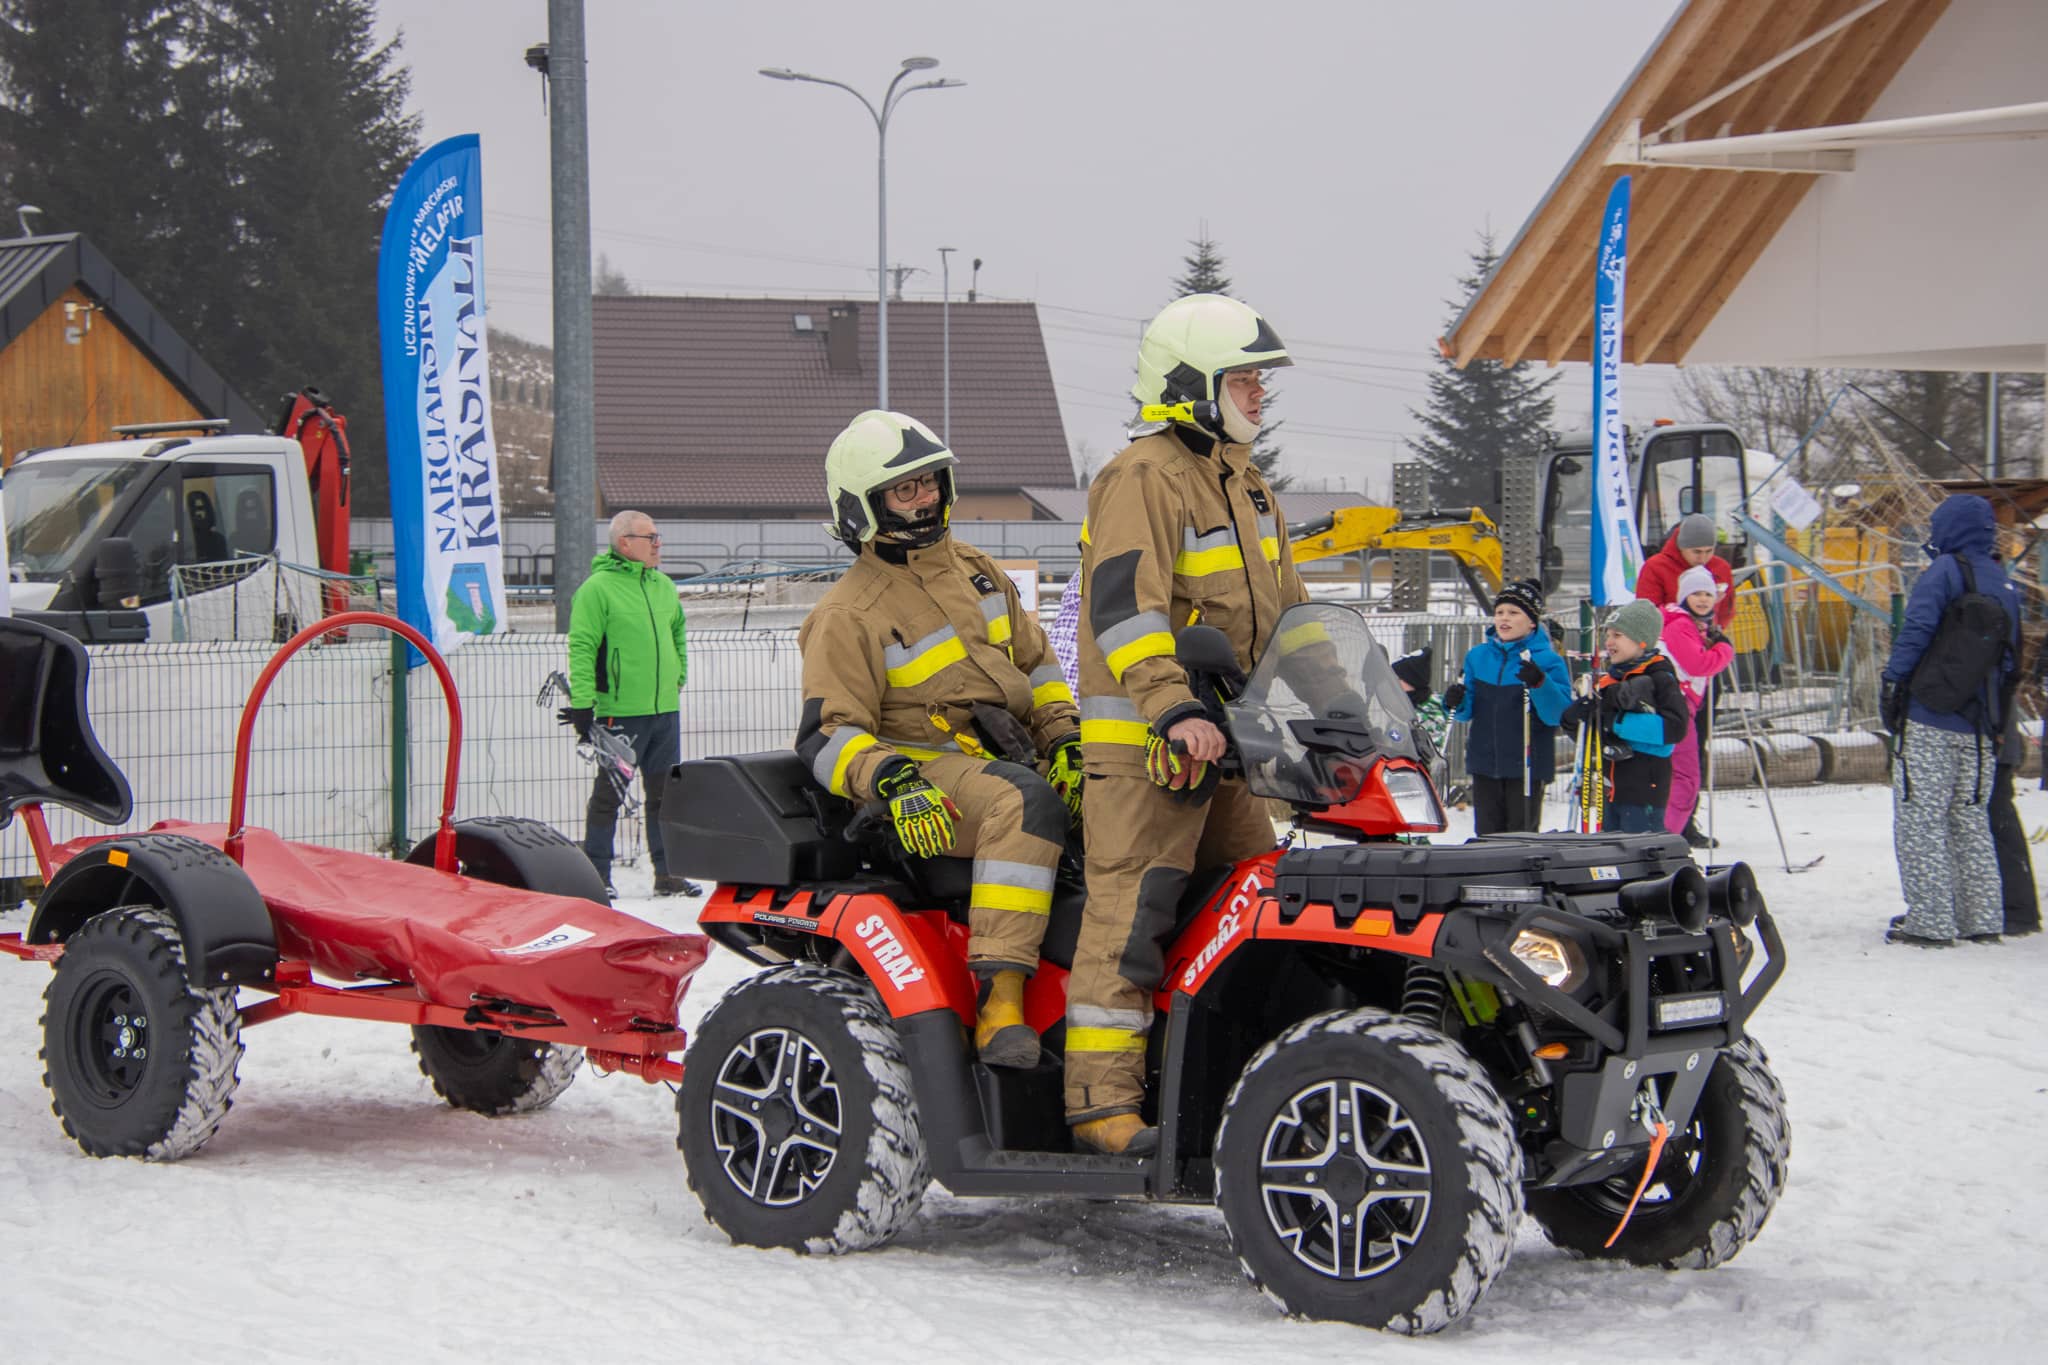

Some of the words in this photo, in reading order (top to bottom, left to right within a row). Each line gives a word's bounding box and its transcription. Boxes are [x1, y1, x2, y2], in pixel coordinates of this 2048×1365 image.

[413, 195, 464, 273] MELAFIR
[404, 261, 417, 356] UCZNIOWSKI
[451, 239, 500, 549] KRASNALI
[855, 914, 925, 992] STRAŻ
